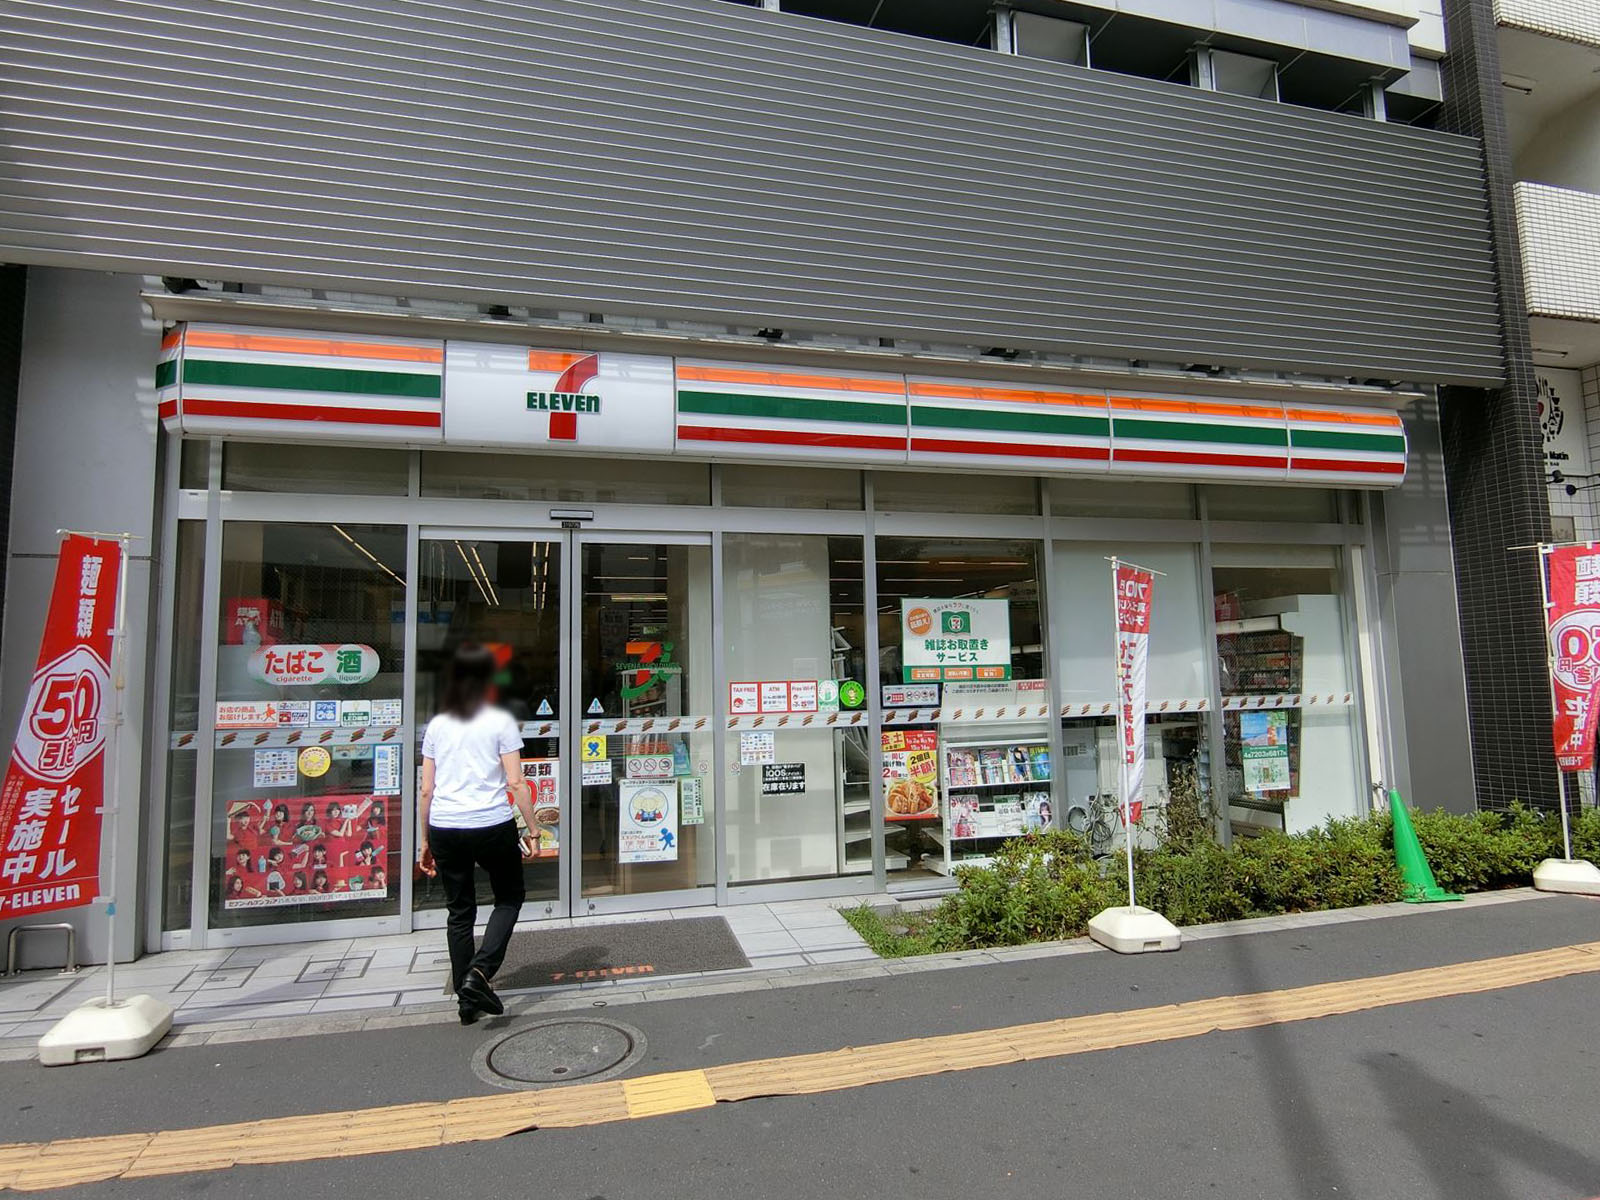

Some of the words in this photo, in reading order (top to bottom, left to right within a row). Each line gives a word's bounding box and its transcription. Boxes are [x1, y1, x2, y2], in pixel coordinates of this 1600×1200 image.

[925, 638, 990, 652] 雑誌お取置き
[265, 650, 324, 675] たばこ
[337, 650, 362, 674] 酒
[936, 652, 979, 662] サービス
[339, 674, 362, 682] liquor
[523, 763, 553, 777] 麺類
[2, 787, 58, 884] 実施中
[39, 785, 81, 879] セール
